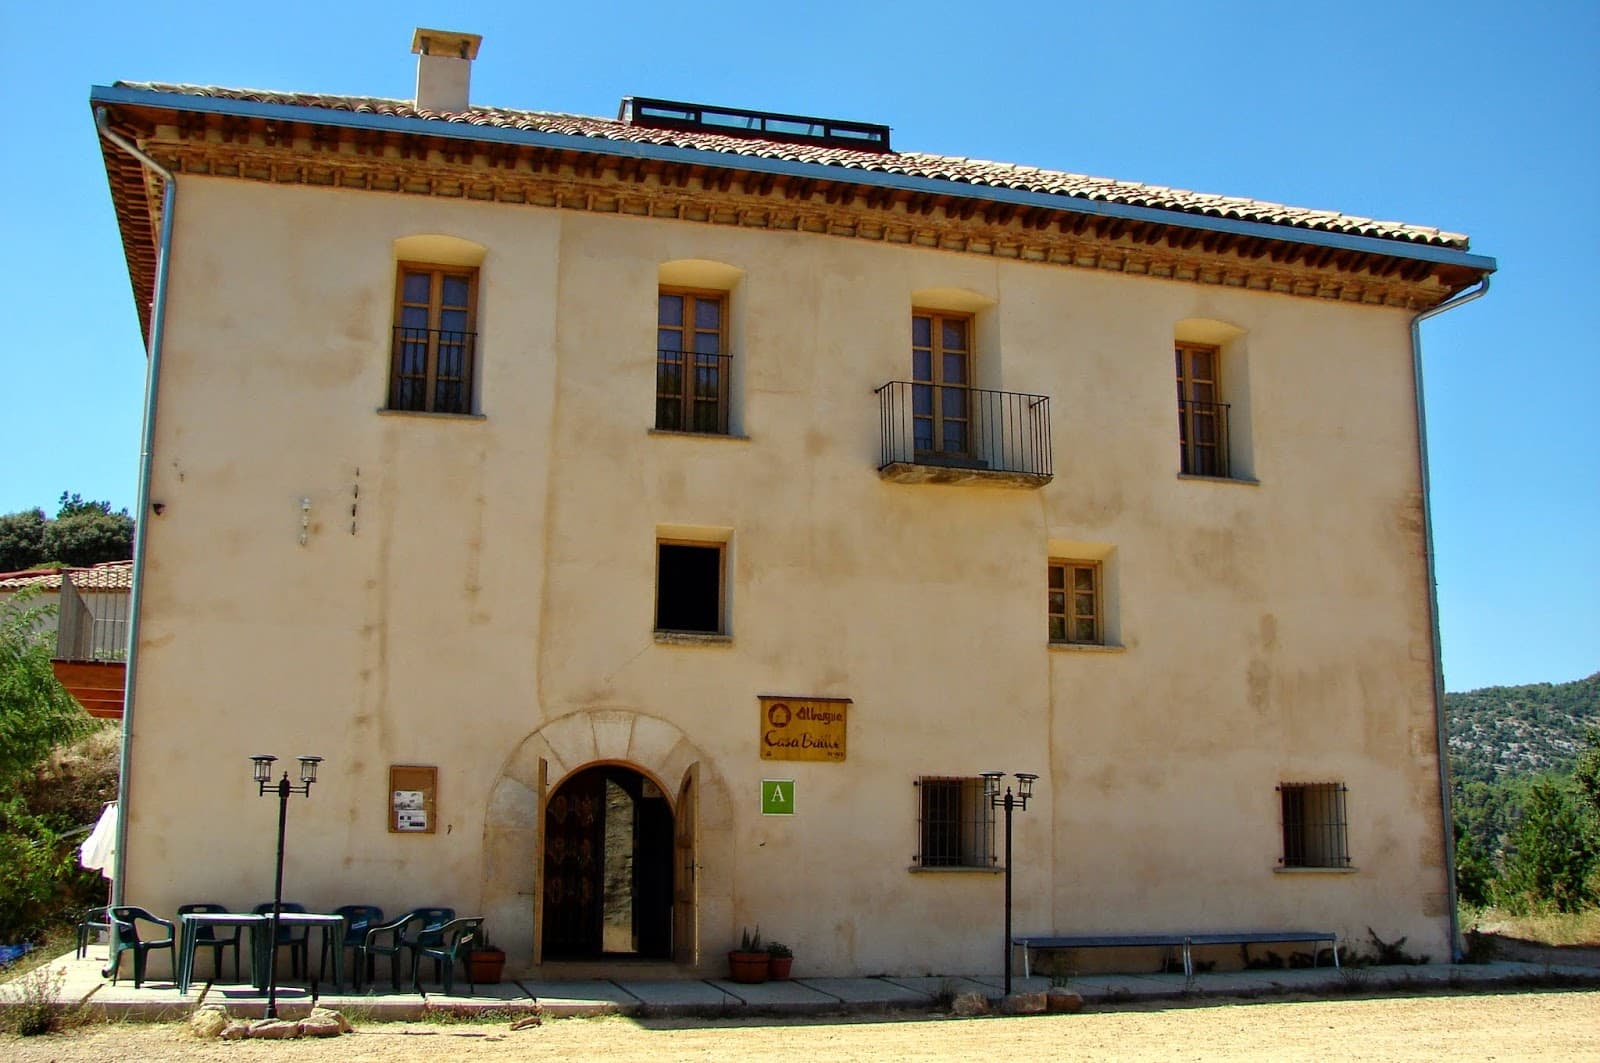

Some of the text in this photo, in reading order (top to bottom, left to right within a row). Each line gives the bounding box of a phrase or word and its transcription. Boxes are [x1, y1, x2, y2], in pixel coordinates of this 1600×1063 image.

[796, 706, 843, 725] Albergue
[764, 730, 799, 748] Casa
[771, 784, 785, 802] A
